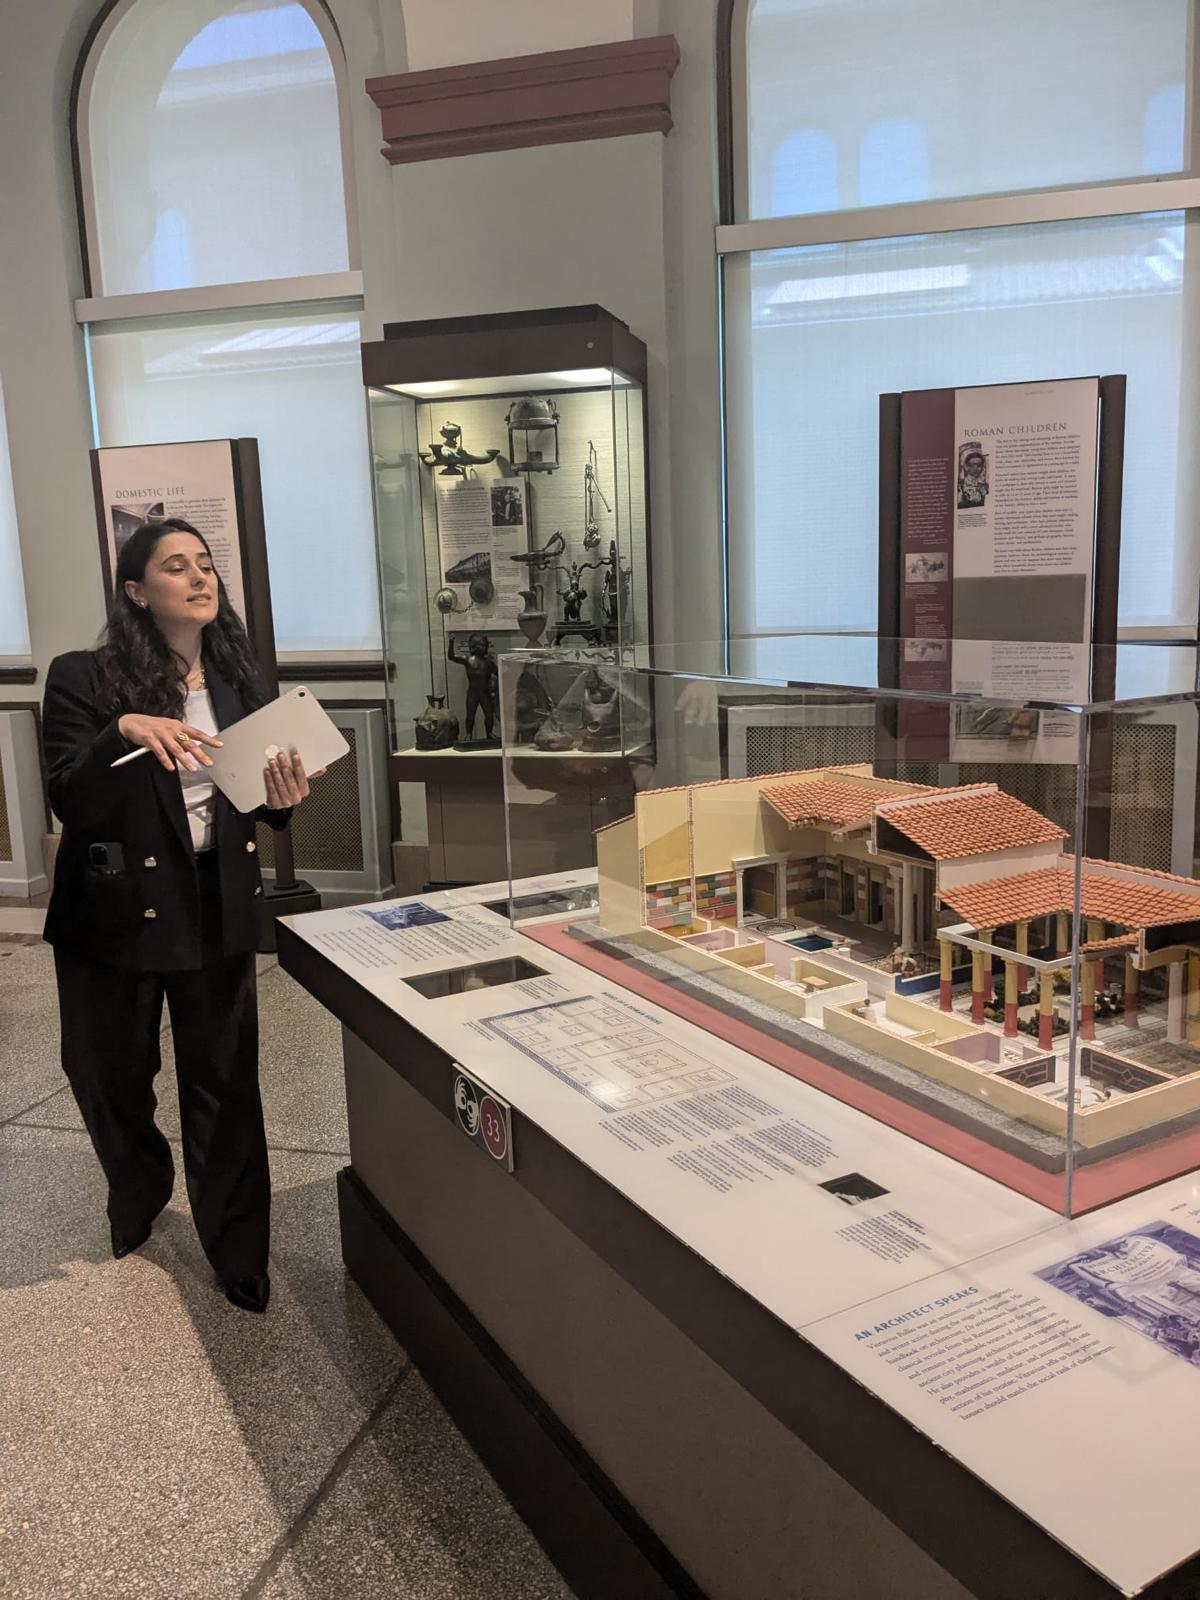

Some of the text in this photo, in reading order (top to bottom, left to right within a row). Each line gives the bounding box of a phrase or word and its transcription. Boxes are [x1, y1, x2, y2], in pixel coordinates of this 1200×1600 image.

[964, 422, 1068, 437] ROMAN CHILDREN
[115, 486, 185, 499] DOMESTIC LIFE
[486, 1113, 500, 1143] 33
[855, 1287, 978, 1340] AN ARCHITECT SPEAKS
